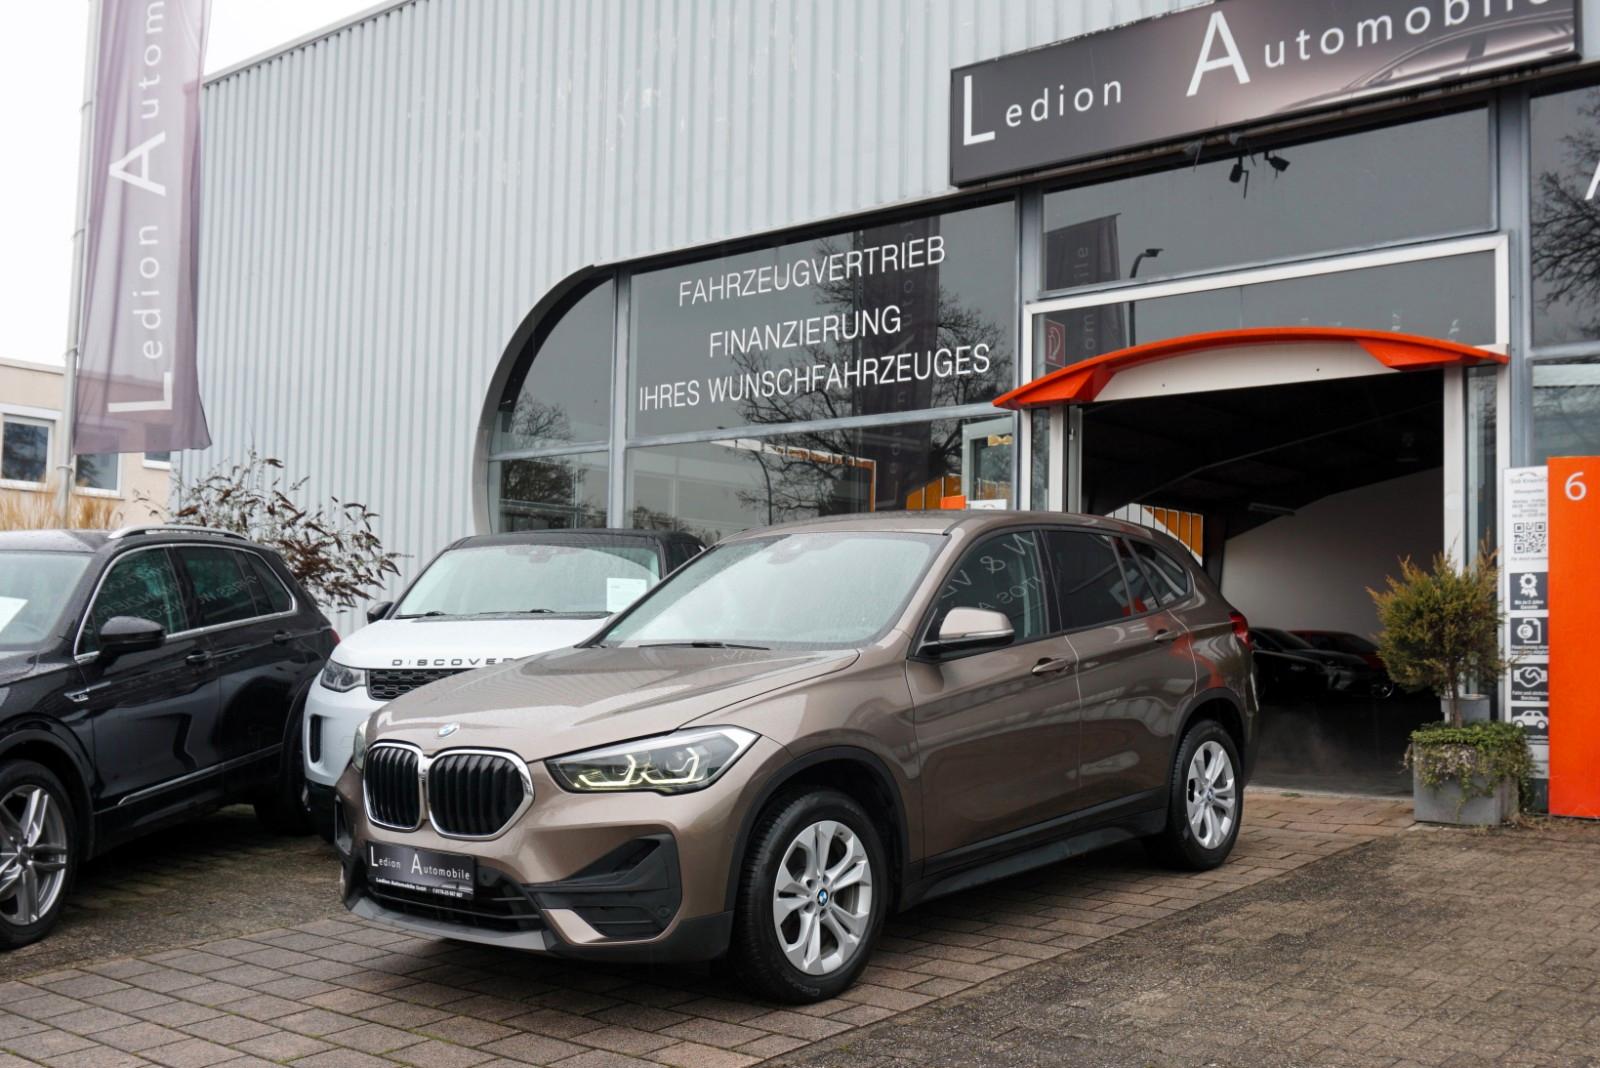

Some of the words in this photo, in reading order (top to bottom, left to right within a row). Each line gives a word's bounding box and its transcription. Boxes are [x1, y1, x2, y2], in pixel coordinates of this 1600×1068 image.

[962, 74, 1122, 146] Ledion
[679, 235, 946, 307] FAHRZEUGVERTRIEB
[108, 225, 172, 413] Ledion
[709, 305, 901, 358] FINANZIERUNG
[639, 379, 700, 411] IHRES
[708, 343, 990, 403] WUNSCHFAHRZEUGES
[1564, 471, 1587, 501] 6
[370, 845, 401, 868] Ledion
[411, 853, 471, 879] Automobile
